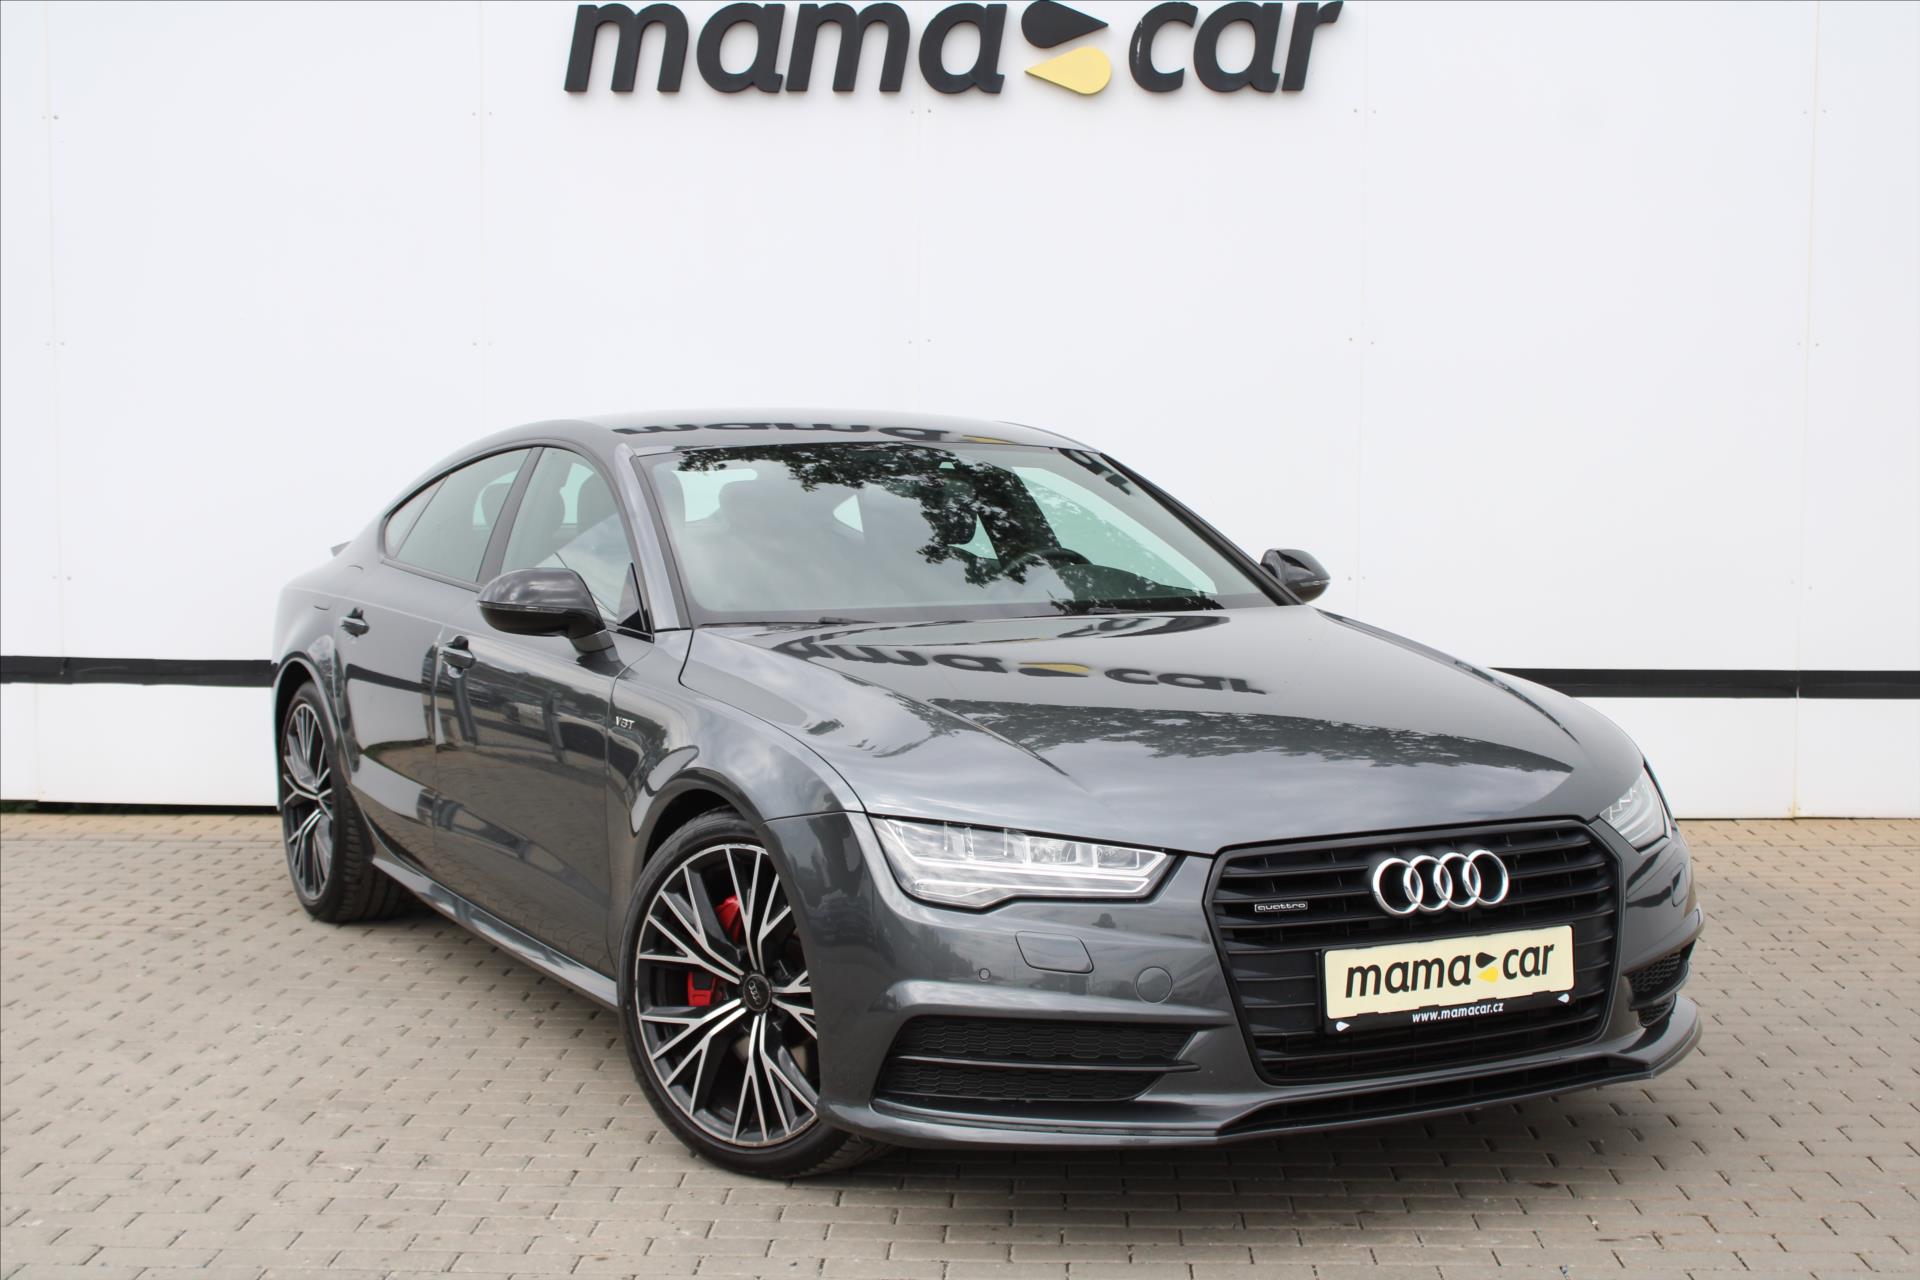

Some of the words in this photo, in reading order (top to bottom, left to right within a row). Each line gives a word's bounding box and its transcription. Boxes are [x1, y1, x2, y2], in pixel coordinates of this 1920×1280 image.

[564, 2, 1006, 95] mama
[1128, 0, 1343, 95] car
[1257, 903, 1306, 912] quattro
[1345, 952, 1471, 998] mama
[1502, 944, 1555, 980] car
[1412, 1002, 1504, 1023] www.mamacar.cz
